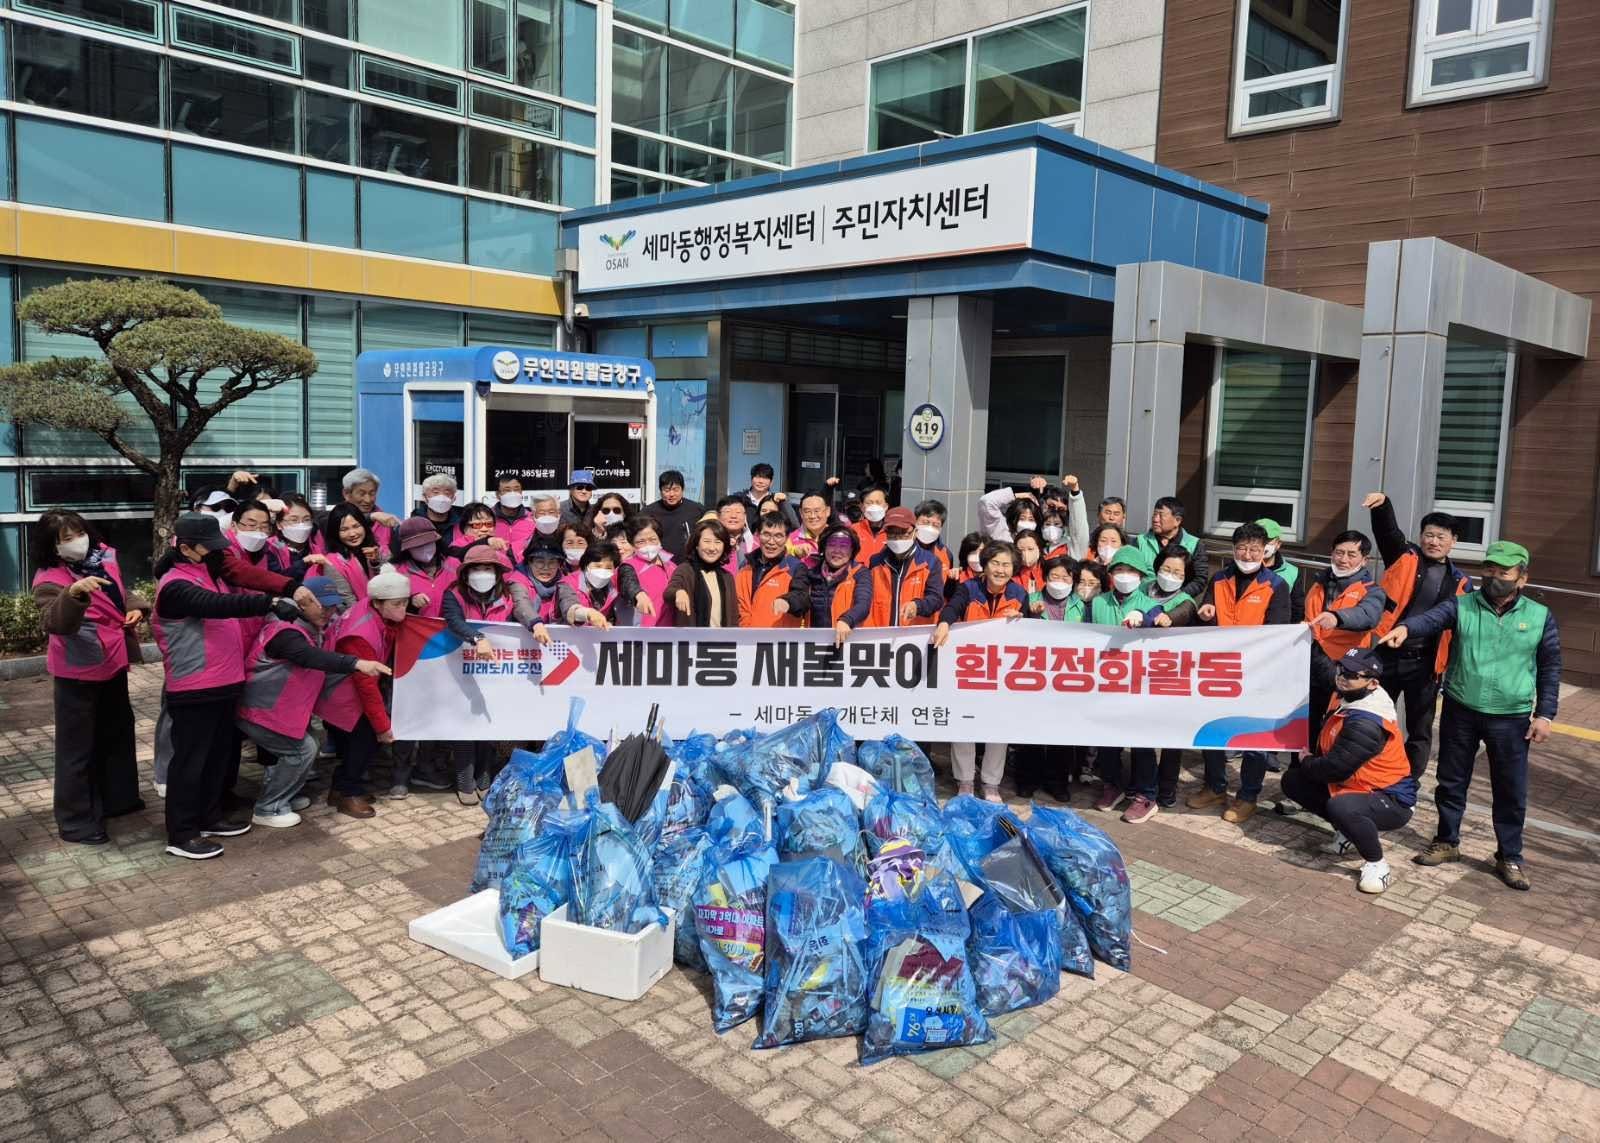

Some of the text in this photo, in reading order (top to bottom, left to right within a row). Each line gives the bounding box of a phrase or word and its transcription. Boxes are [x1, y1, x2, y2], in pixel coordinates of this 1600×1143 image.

[642, 183, 990, 263] 세마동행정복지센터 주민자치센터
[605, 257, 629, 271] OSAN
[523, 357, 641, 384] 무인민원발급창구
[915, 422, 939, 435] 419
[517, 649, 542, 660] 변화
[462, 662, 542, 674] 미래도시 오산
[595, 640, 1244, 698] 세마동 새봄맞이 환경정화활동
[827, 705, 899, 725] 개단체
[911, 705, 951, 725] 연합
